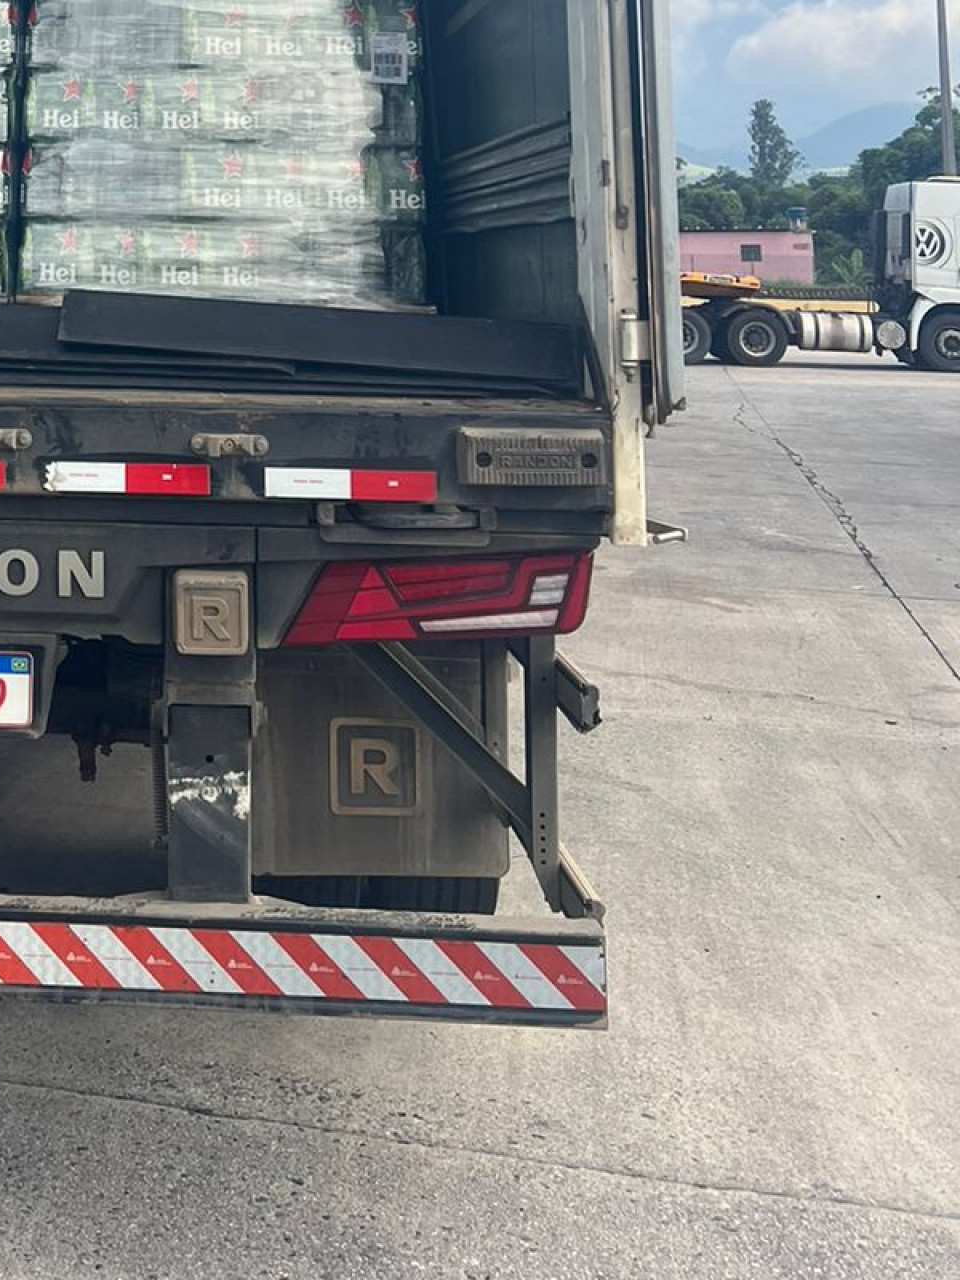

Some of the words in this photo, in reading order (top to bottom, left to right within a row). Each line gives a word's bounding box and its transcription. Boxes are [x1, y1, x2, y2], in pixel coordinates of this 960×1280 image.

[0, 36, 18, 54] ei
[204, 37, 240, 55] Hei
[266, 37, 302, 55] Hei
[326, 36, 363, 55] Hei
[406, 36, 422, 55] ei
[43, 110, 79, 128] Hei
[103, 110, 138, 128] Hei
[163, 110, 198, 128] Hei
[204, 189, 240, 207] Hei
[266, 189, 301, 207] Hei
[328, 189, 365, 208] Hei
[39, 264, 75, 283] Hei
[101, 266, 136, 283] Hei
[161, 266, 198, 285] Hei
[499, 455, 574, 468] RANDON
[191, 597, 231, 641] R
[351, 739, 398, 796] R
